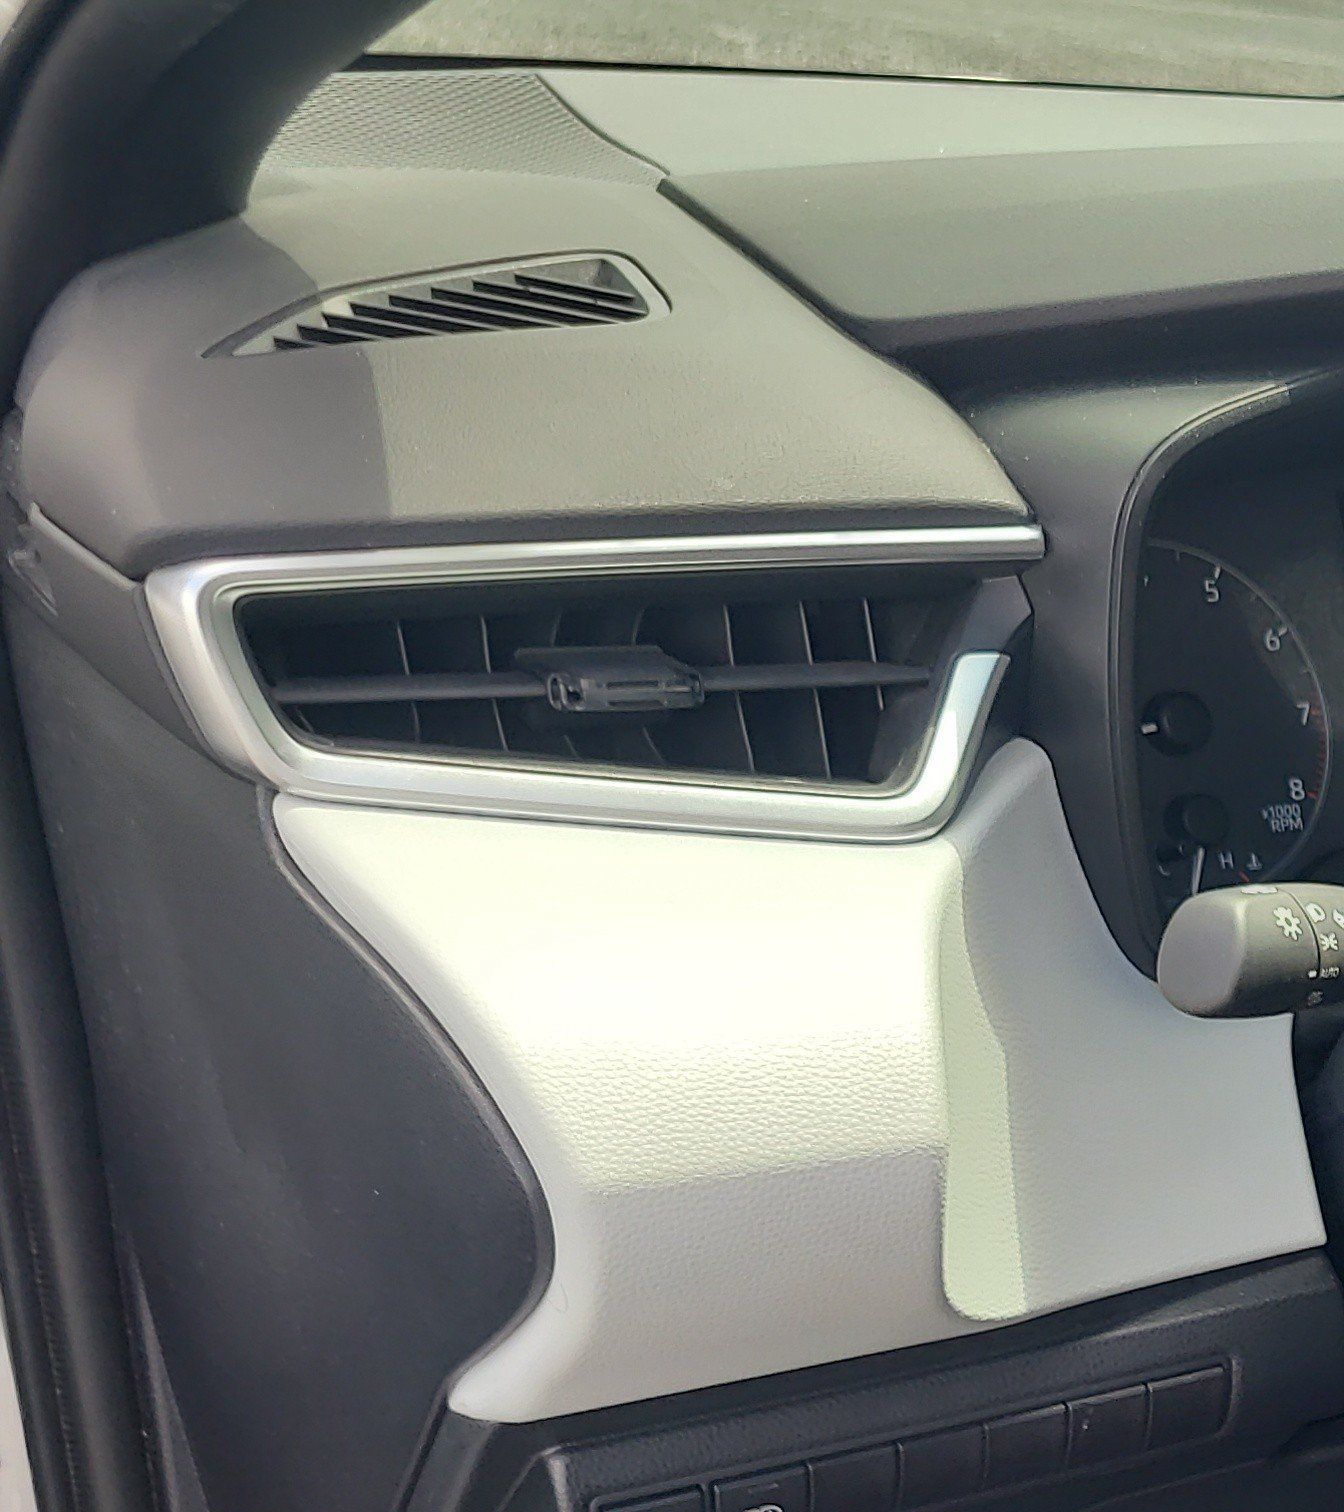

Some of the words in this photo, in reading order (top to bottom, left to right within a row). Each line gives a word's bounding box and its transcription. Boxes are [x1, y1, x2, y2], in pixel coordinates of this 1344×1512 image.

[1203, 578, 1219, 603] 5
[1264, 628, 1281, 652] 6
[1296, 701, 1311, 726] 7
[1288, 776, 1305, 802] 8
[1270, 818, 1303, 832] RPM
[1218, 851, 1235, 869] H
